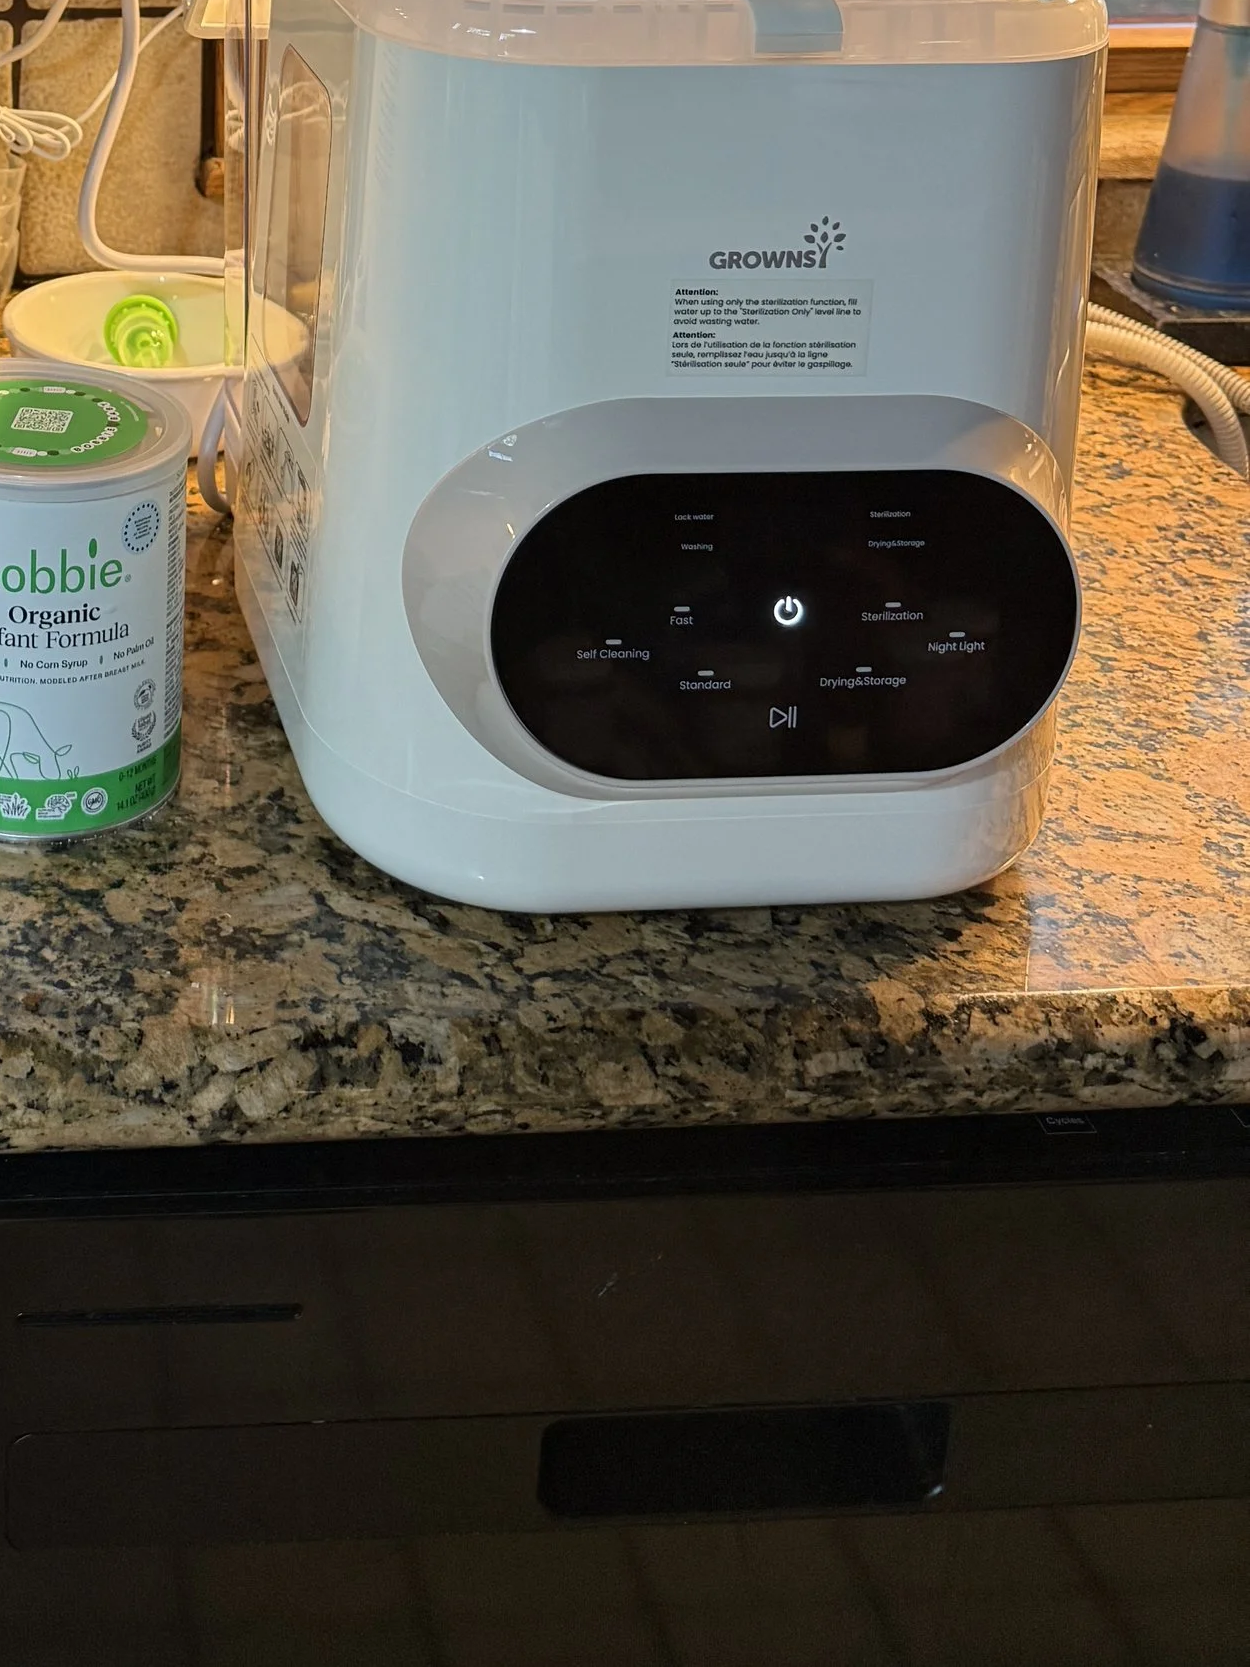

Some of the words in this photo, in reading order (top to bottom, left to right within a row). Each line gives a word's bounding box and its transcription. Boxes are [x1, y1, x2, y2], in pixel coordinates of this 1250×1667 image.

[701, 299, 724, 307] using
[810, 298, 846, 306] function,
[699, 318, 732, 326] wasting
[808, 351, 828, 359] ligne
[807, 361, 853, 369] gaspillage.
[681, 543, 713, 552] Washing
[868, 540, 925, 549] Drying&Storage
[8, 603, 101, 630] Organic
[670, 616, 694, 625] Fast
[861, 611, 924, 621] Sterilization
[46, 622, 130, 649] Formula
[113, 650, 125, 661] No
[126, 643, 145, 657] Palm
[145, 637, 155, 647] Oil
[928, 642, 957, 654] Night
[959, 641, 985, 653] Light
[576, 649, 597, 659] Self
[599, 648, 650, 661] Cleaning
[20, 660, 34, 669] No
[36, 660, 59, 669] Corn
[62, 659, 88, 669] Syrup
[79, 673, 103, 682] AFTER
[104, 667, 130, 678] BREAST
[679, 680, 731, 690] Standard
[820, 676, 907, 689] Drying&Storage
